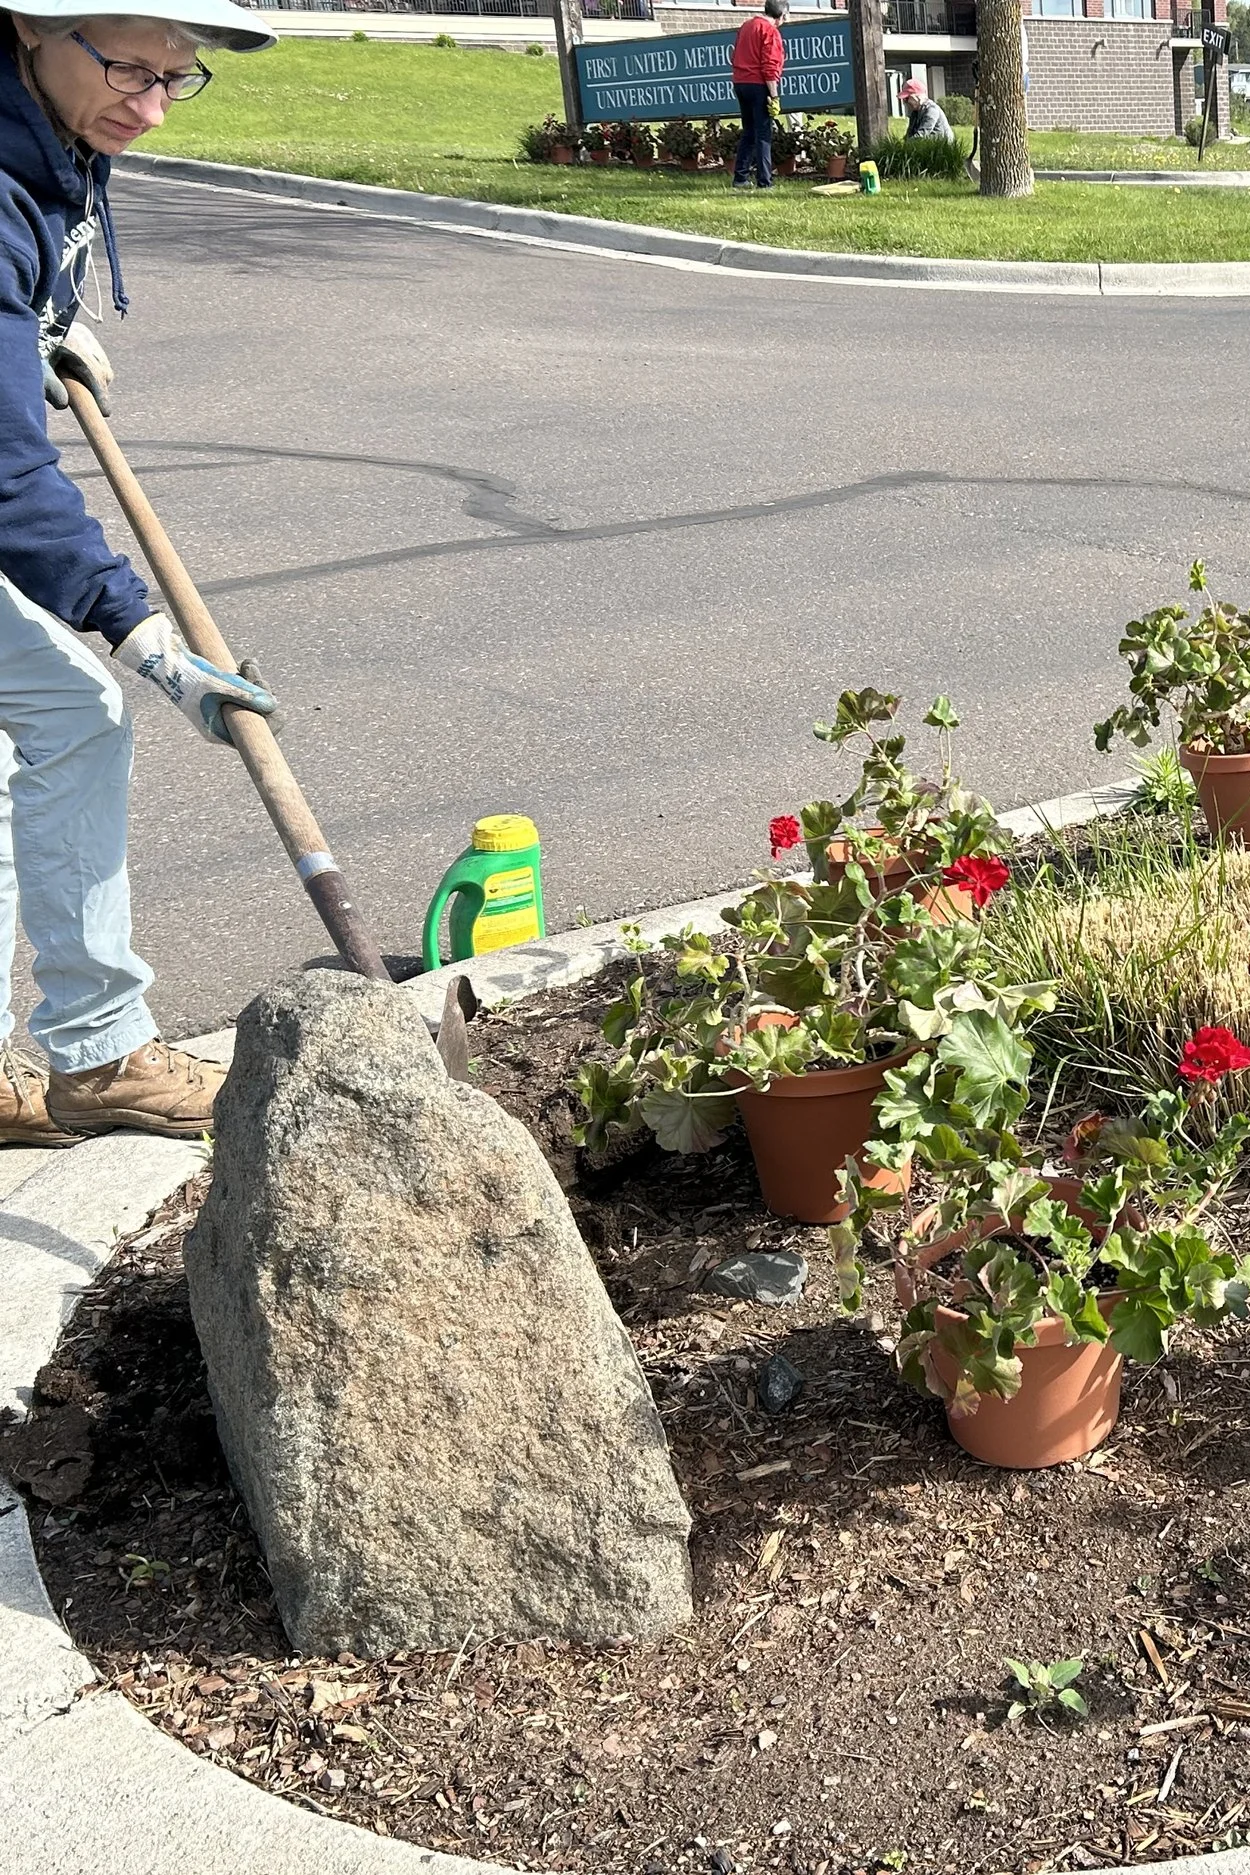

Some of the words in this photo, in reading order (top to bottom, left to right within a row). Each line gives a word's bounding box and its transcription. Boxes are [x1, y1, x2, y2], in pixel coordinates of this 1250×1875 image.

[585, 57, 618, 80] FIRST
[624, 49, 677, 76] UNITED
[683, 44, 735, 70] METHO
[782, 34, 845, 61] CHURCH
[1203, 28, 1224, 48] EXIT
[596, 85, 676, 110] UNIVERSITY
[677, 81, 736, 103] NURSER
[780, 72, 840, 96] PERTOP
